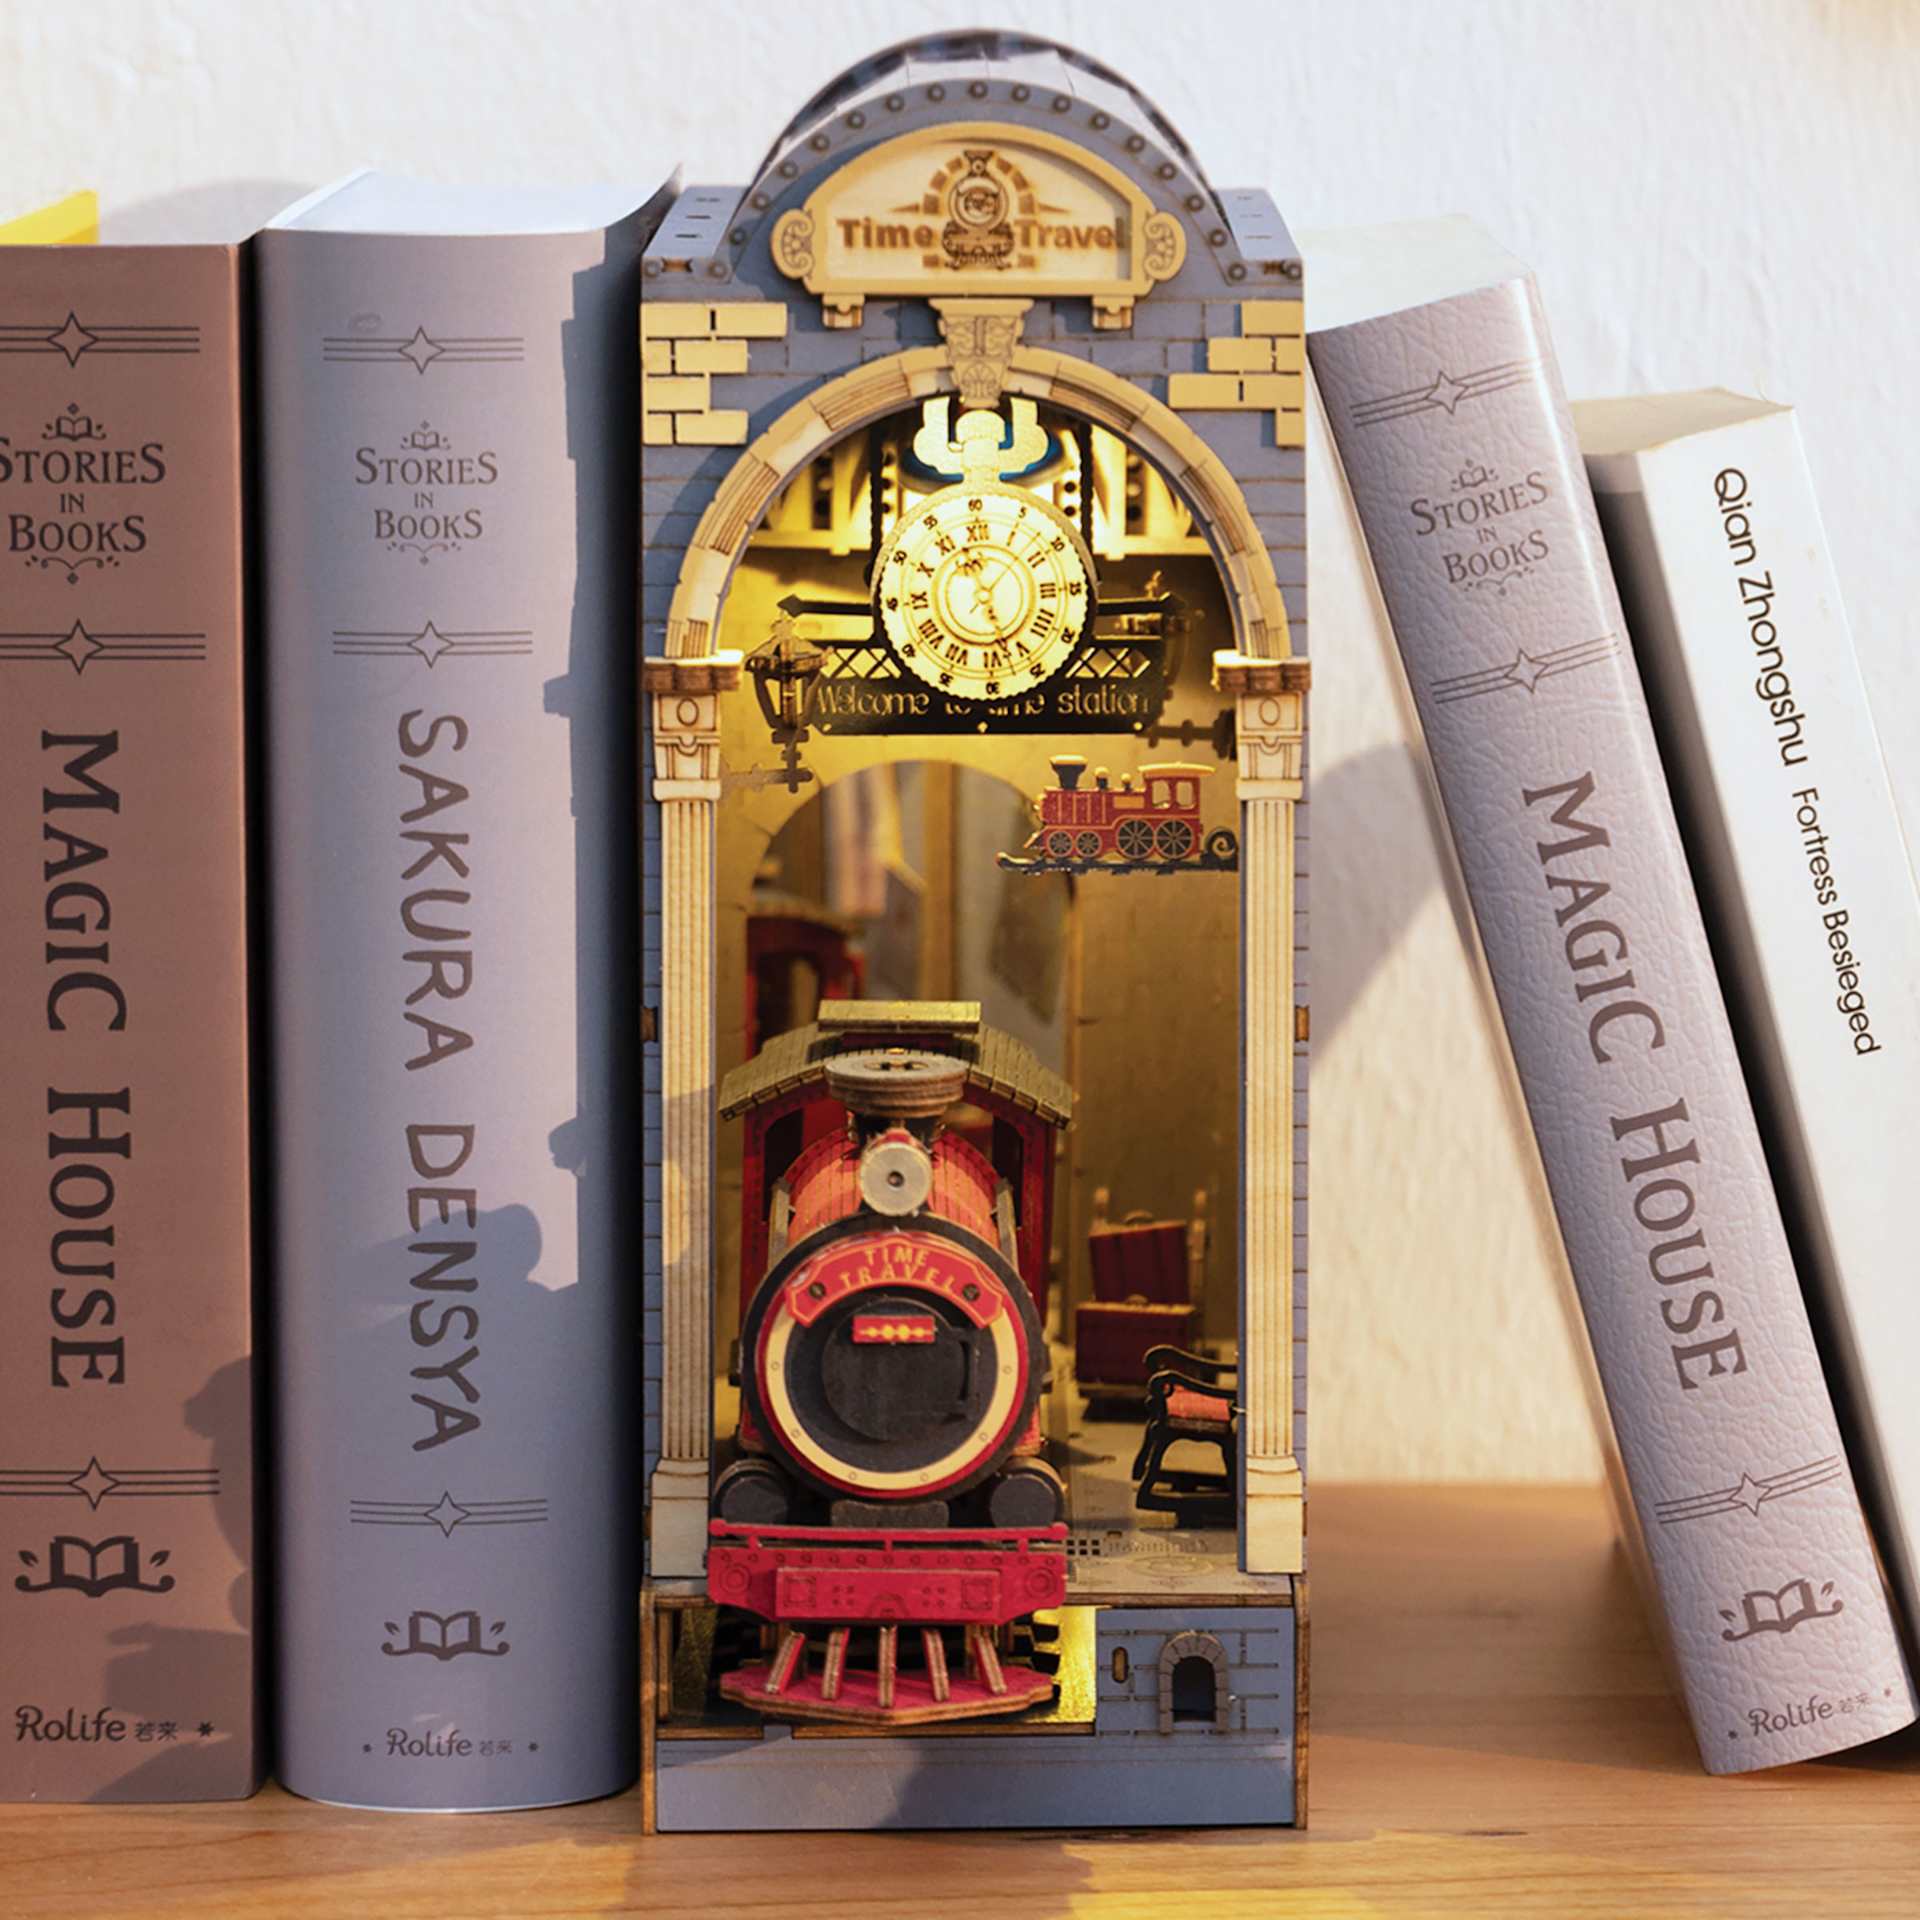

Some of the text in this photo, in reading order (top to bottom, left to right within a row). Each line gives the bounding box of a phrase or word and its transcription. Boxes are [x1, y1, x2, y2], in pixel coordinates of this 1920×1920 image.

[835, 217, 1125, 250] Time Travel
[355, 447, 498, 485] STORIES
[60, 493, 85, 513] IN
[414, 492, 434, 509] IN
[1410, 472, 1548, 536] STORIES
[8, 514, 147, 552] BOOKS
[374, 509, 483, 539] BOOKS
[1476, 525, 1499, 545] IN
[1442, 529, 1549, 583] BOOKS
[1713, 467, 1808, 768] Qian Zhongshu
[816, 684, 931, 716] Welcome
[1057, 683, 1150, 716] station
[1791, 787, 1881, 1057] Fortress Besieged
[41, 730, 133, 1388] MAGIC HOUSE
[398, 709, 481, 1452] SAKURA DENSYA
[1522, 770, 1749, 1391] MAGIC HOUSE
[864, 1246, 930, 1266] TIME
[839, 1263, 956, 1296] TRAVEL
[15, 1704, 127, 1743] Rolife
[1748, 1693, 1833, 1737] Rolife
[386, 1727, 473, 1758] Rolife
